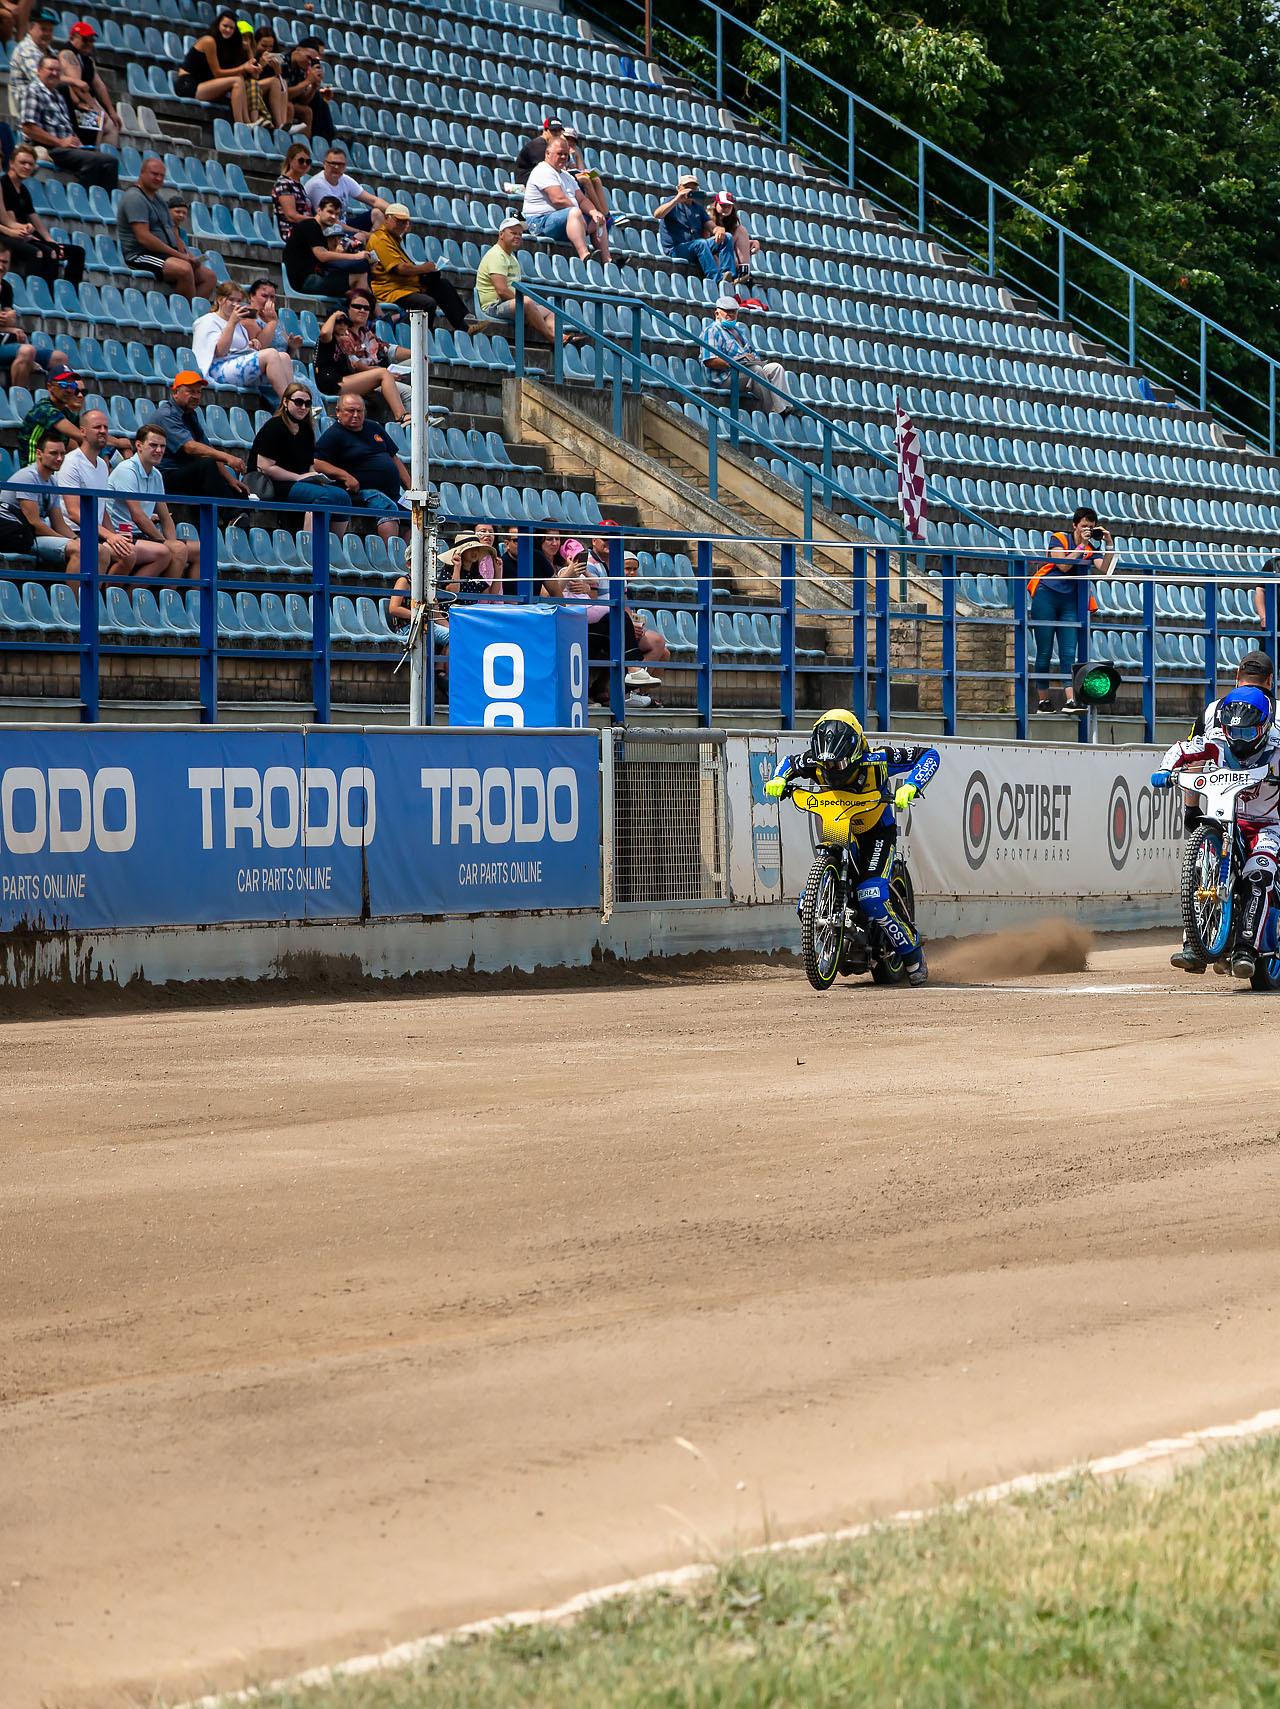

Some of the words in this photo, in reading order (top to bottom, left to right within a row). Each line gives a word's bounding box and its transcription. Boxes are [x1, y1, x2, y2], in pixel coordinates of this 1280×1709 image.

[1210, 773, 1250, 783] OPTIBET
[0, 767, 137, 854] ODO
[188, 767, 376, 849] TRODO
[421, 767, 579, 844] TRODO
[820, 799, 866, 808] spechouse
[997, 783, 1071, 841] OPTIBET
[1137, 785, 1189, 841] OPTIB
[996, 848, 1038, 861] SPORTA
[1044, 846, 1070, 861] BĀRS
[1136, 848, 1171, 860] SPORTA
[237, 869, 259, 892] CAR
[262, 868, 294, 891] PARTS
[297, 867, 332, 890] ONLINE
[458, 863, 479, 886] CAR
[480, 862, 507, 885] PARTS
[510, 861, 542, 884] ONLINE
[3, 875, 40, 900] PARTS
[43, 874, 86, 899] ONLINE
